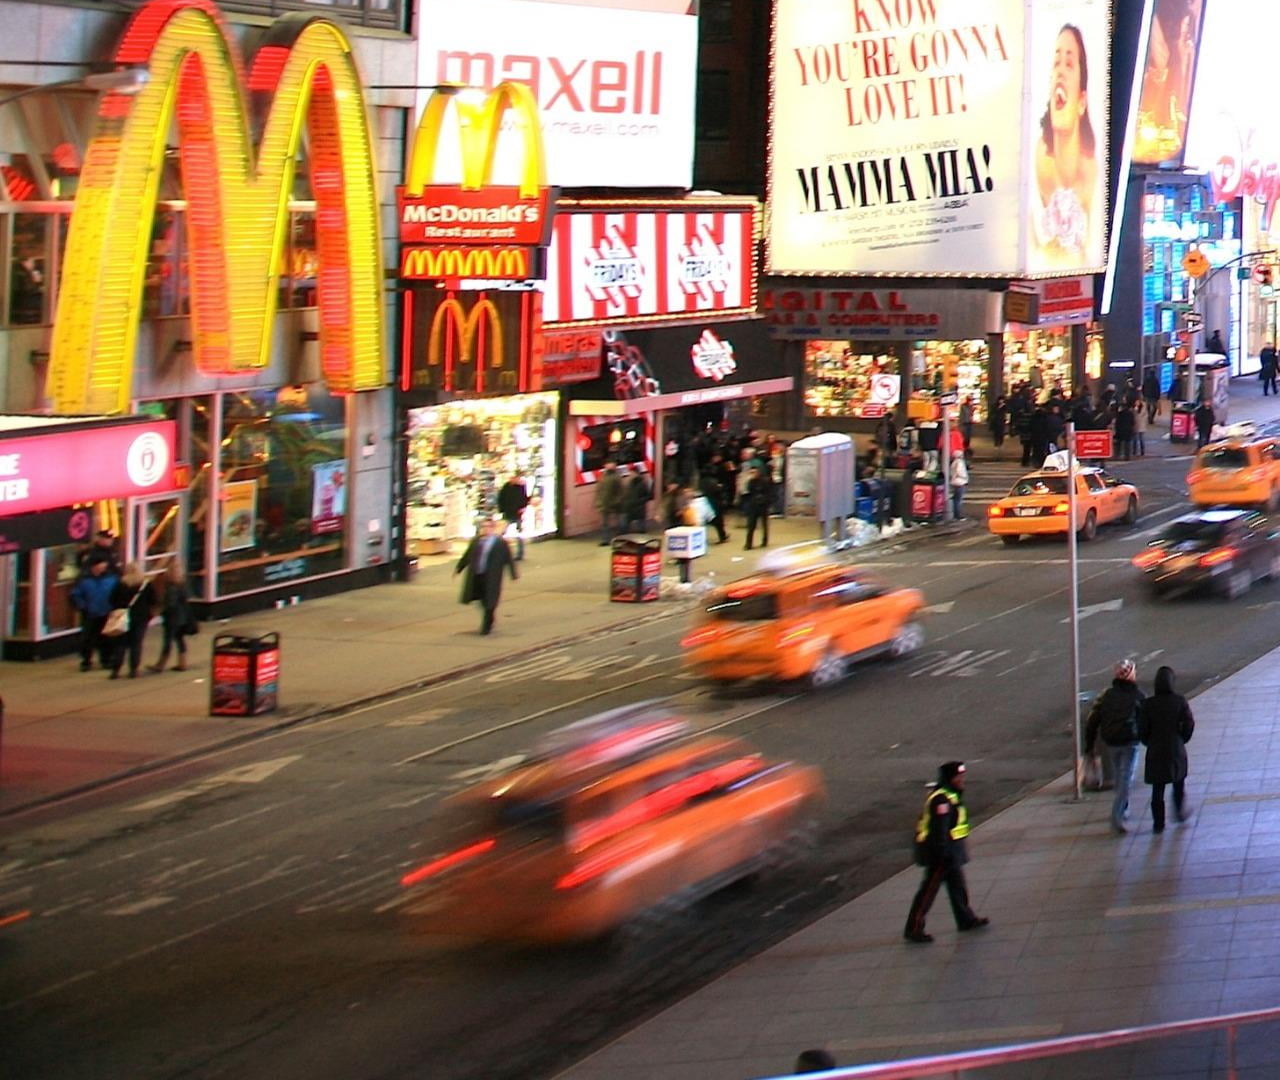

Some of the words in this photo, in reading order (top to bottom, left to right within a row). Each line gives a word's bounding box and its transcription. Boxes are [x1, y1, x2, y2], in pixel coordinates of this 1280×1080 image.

[437, 50, 662, 115] maxell
[793, 36, 900, 86] YOU'RE
[909, 24, 1009, 71] GONNA
[845, 79, 920, 127] LOVE
[928, 73, 968, 117] IT!
[796, 156, 917, 214] MAMMA
[923, 144, 993, 200] MIA!
[403, 203, 539, 223] McDonald's
[425, 226, 516, 238] Restaurant
